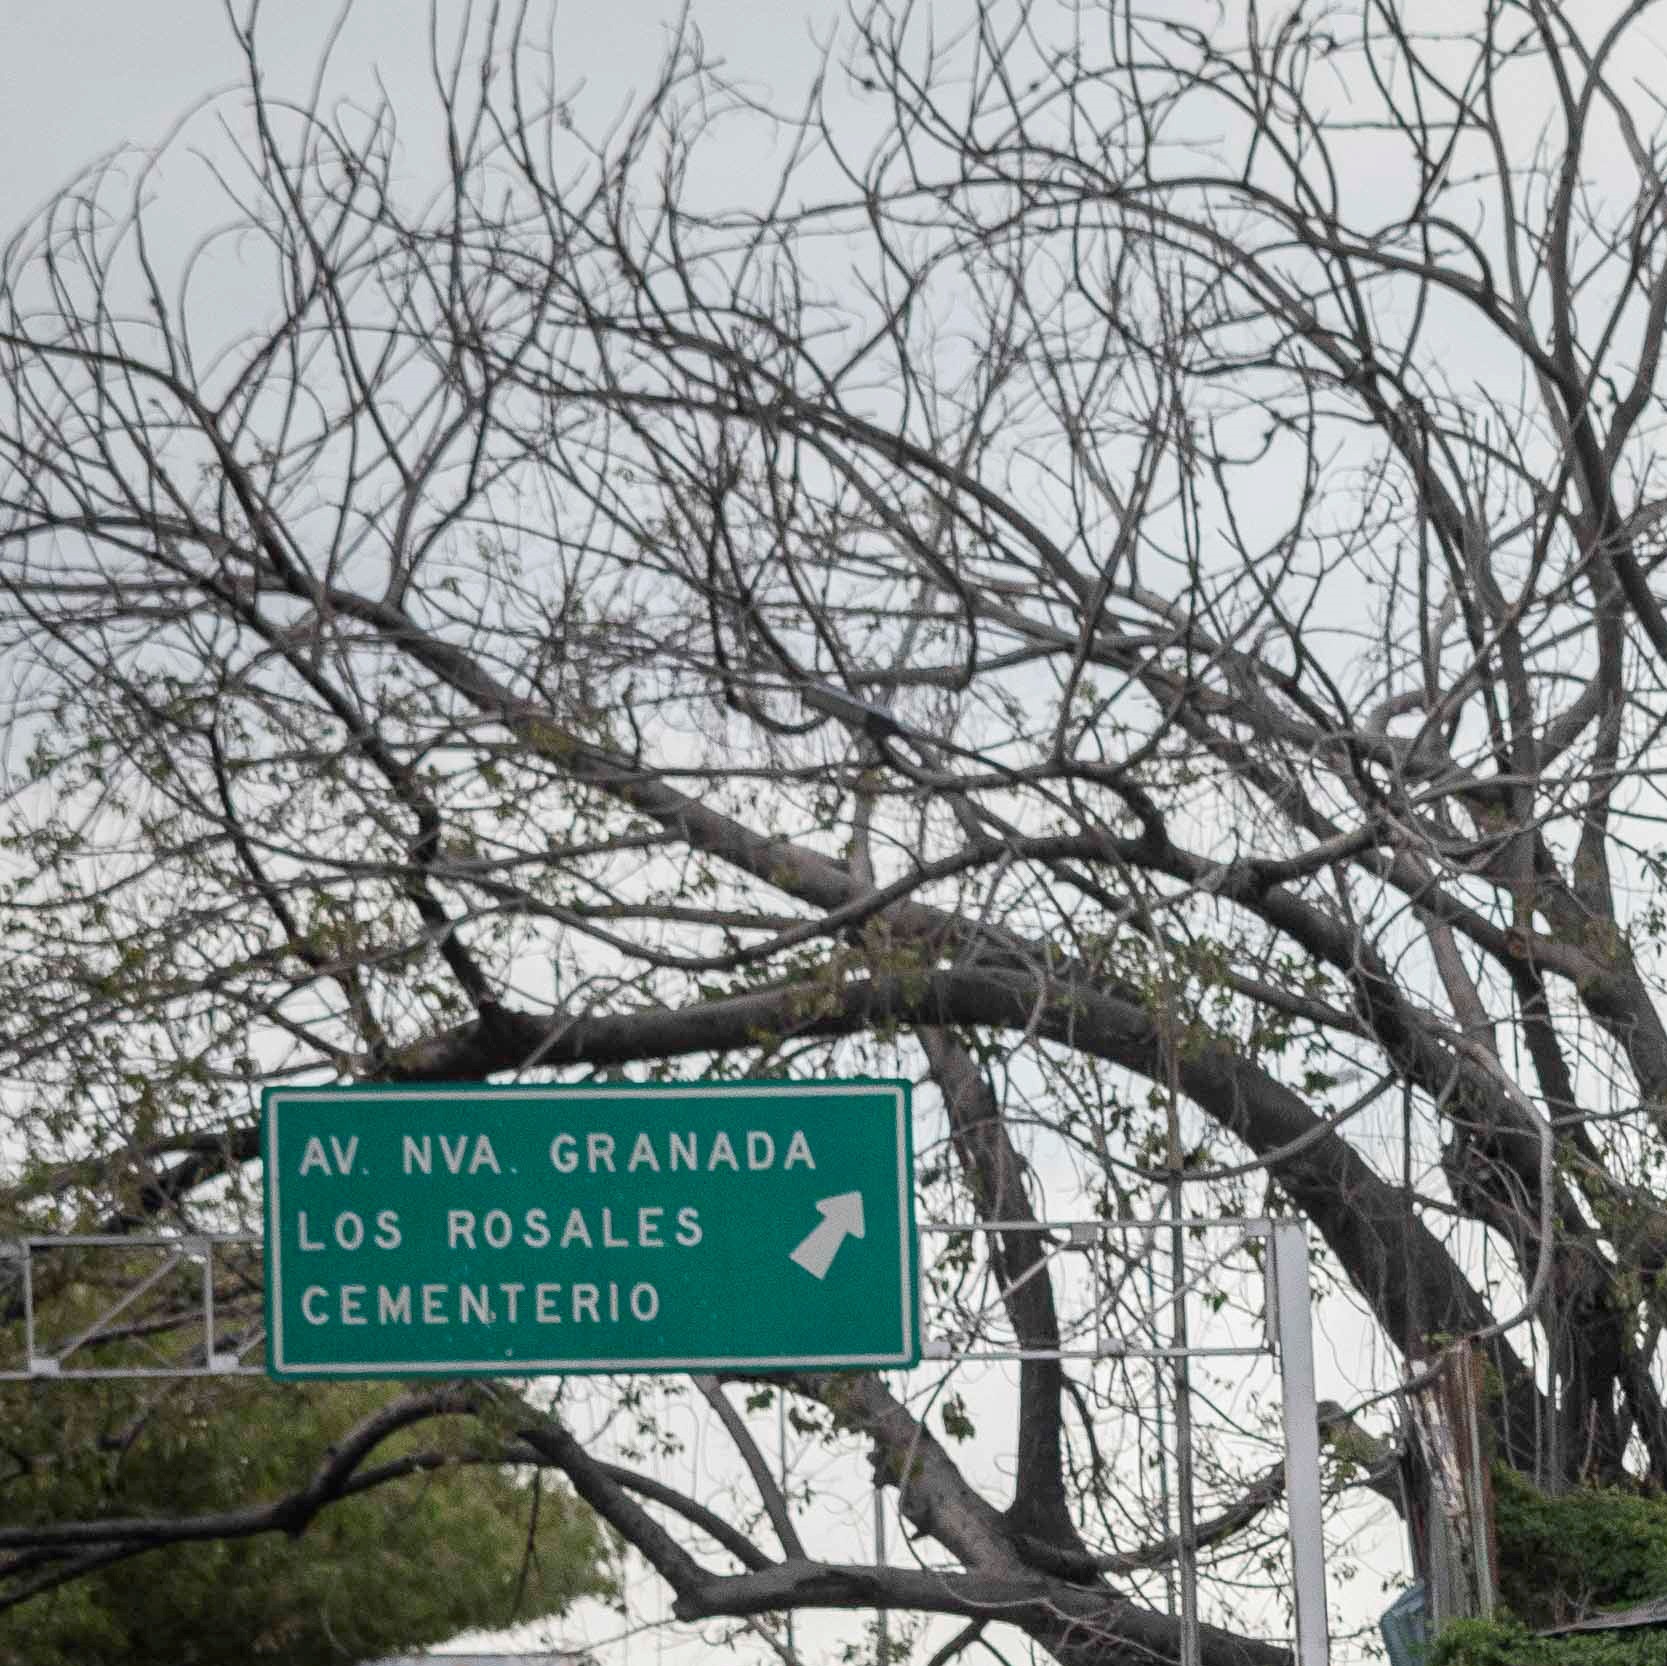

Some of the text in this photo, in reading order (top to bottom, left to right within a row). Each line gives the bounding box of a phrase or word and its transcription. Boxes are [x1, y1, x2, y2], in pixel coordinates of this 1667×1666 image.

[299, 1130, 817, 1176] AV. NVA. GRANADA
[297, 1206, 703, 1251] LOS ROSALES
[301, 1282, 660, 1325] CEMENTERIO
